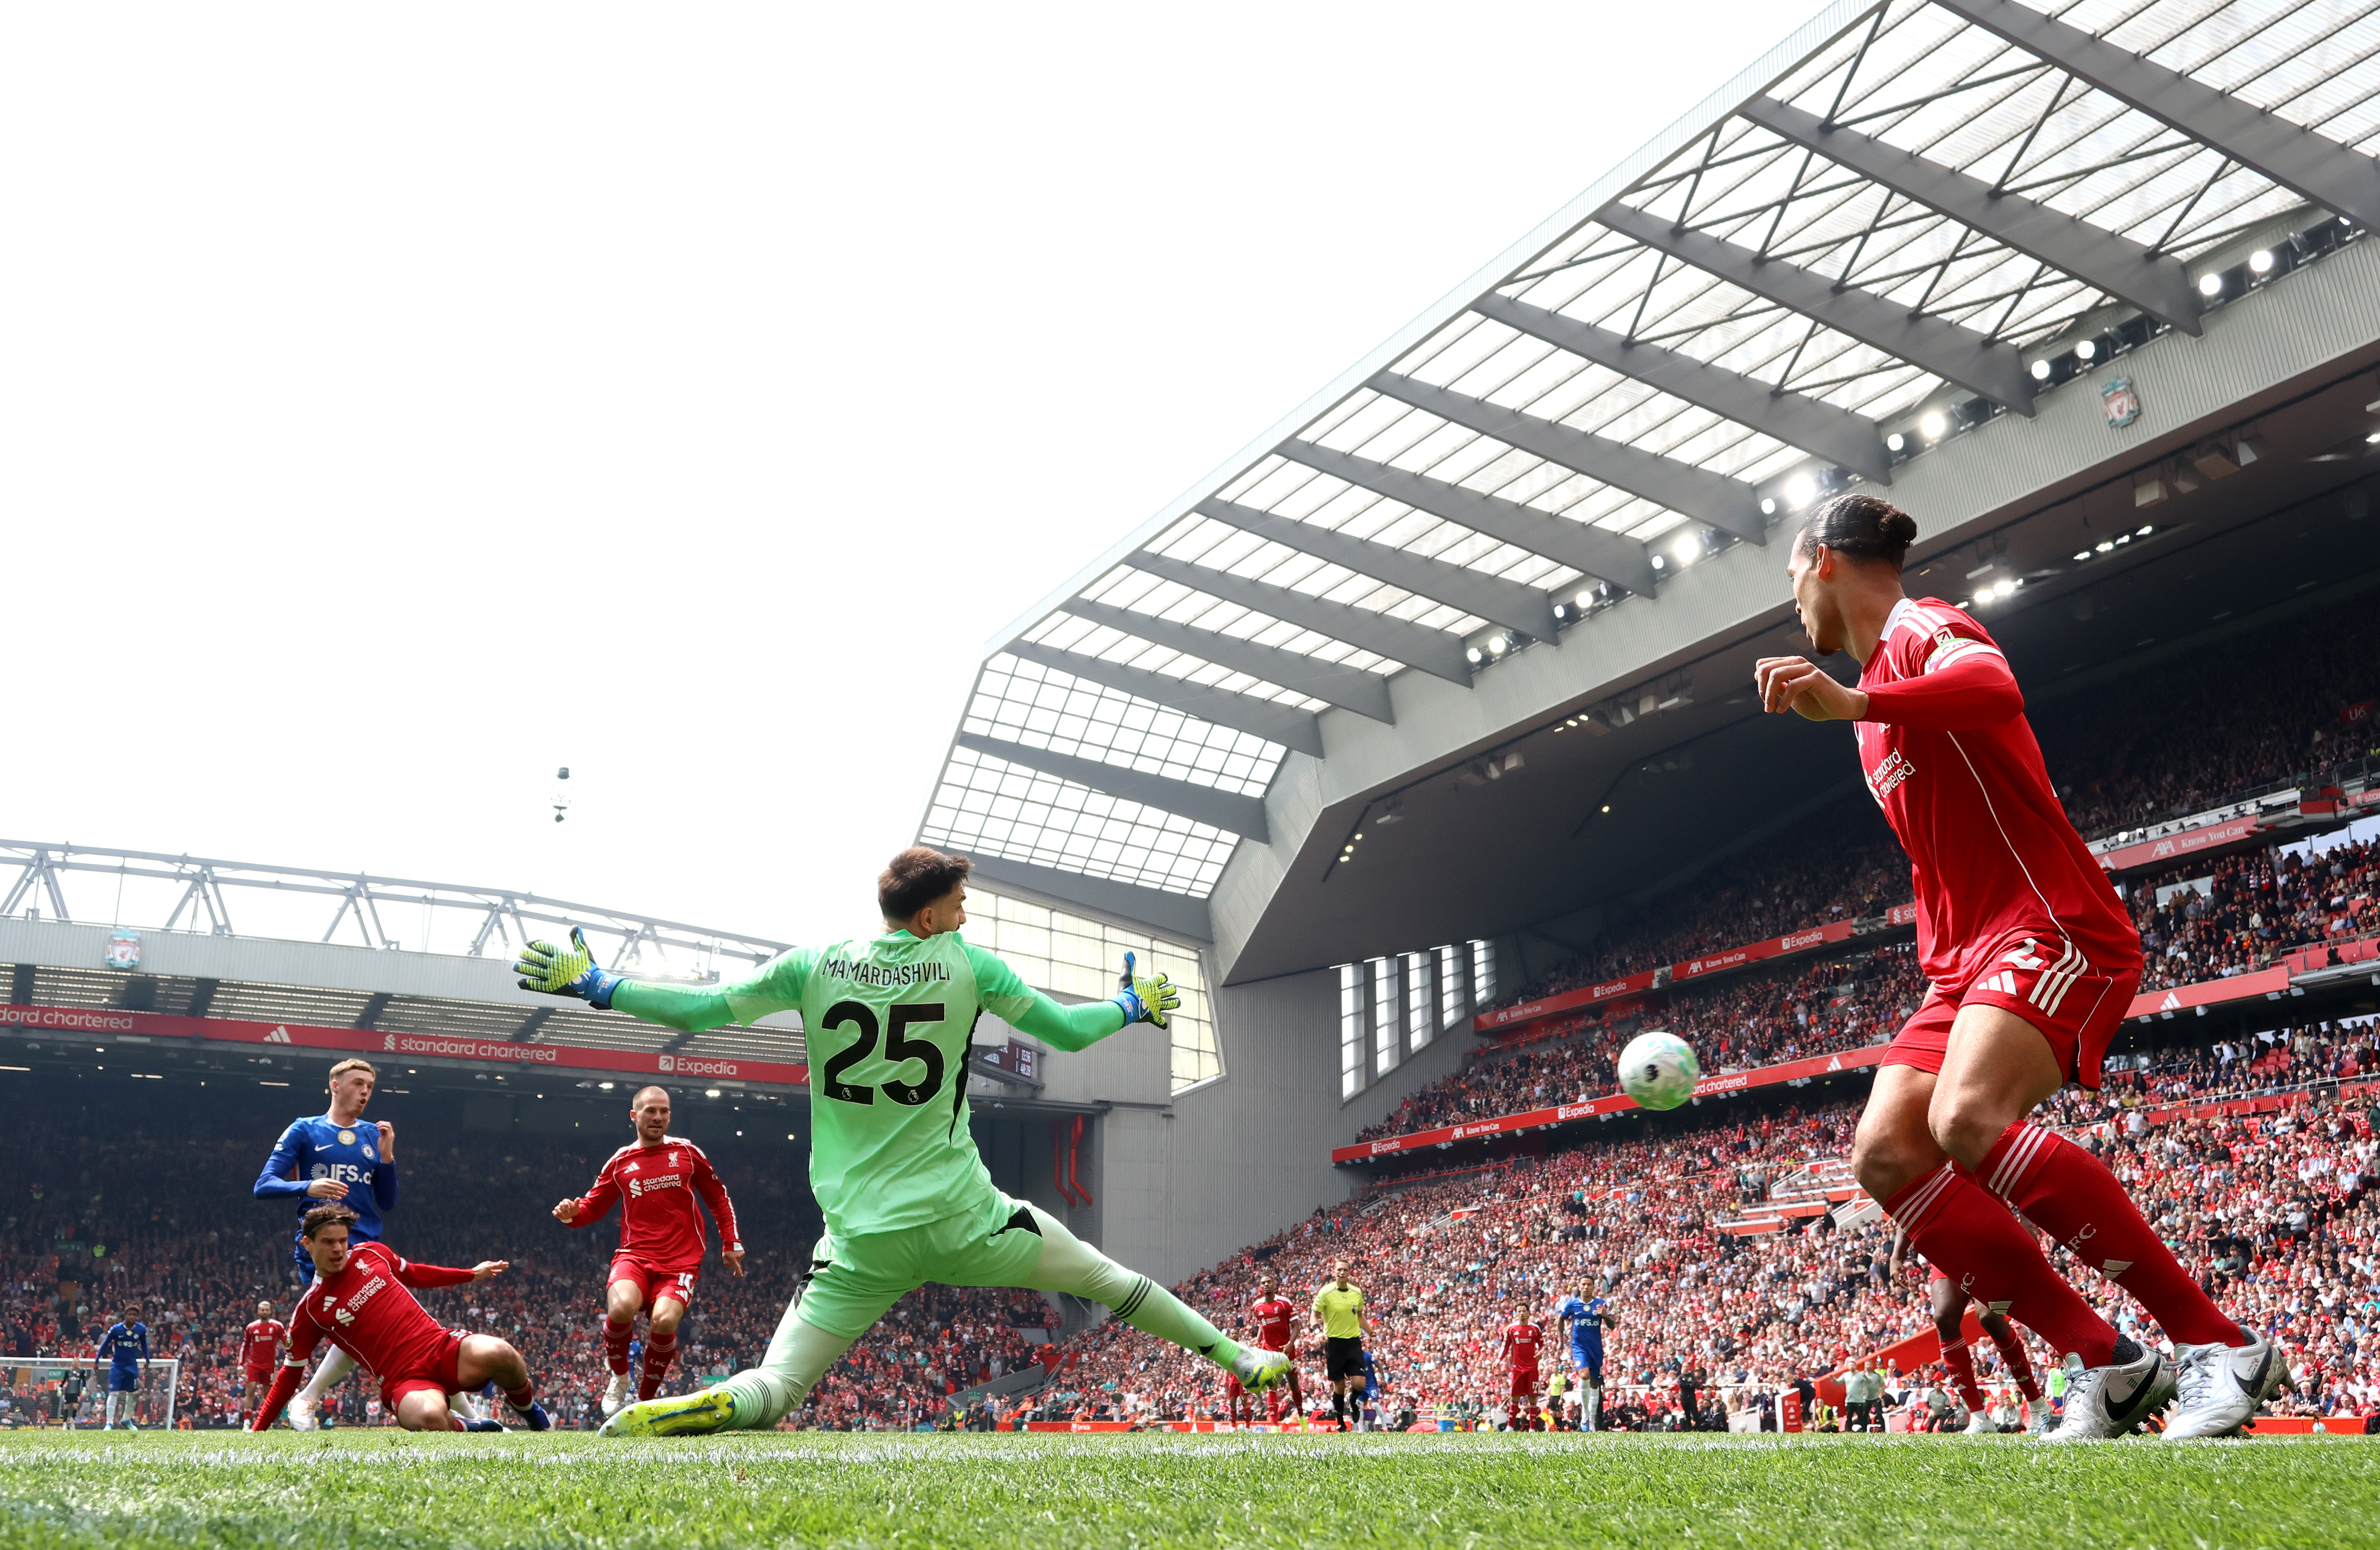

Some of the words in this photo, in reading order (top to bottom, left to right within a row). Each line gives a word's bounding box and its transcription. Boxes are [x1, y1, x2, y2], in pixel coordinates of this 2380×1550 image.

[1872, 747, 1902, 785] standard
[1879, 760, 1916, 799] chartered
[2151, 839, 2176, 858] AXA
[2181, 835, 2207, 848] Know
[2208, 832, 2226, 841] You
[2226, 826, 2245, 837] Can
[1791, 931, 1823, 947] Expedia
[821, 958, 951, 986] MAMARDASHVILI
[43, 1010, 133, 1029] chartered
[400, 1038, 475, 1055] standard
[478, 1043, 556, 1061] chartered
[821, 1000, 945, 1106] 25
[676, 1057, 737, 1075] Expedia
[1706, 1074, 1747, 1092] chartered
[1566, 1103, 1595, 1118] Expedia
[330, 1164, 375, 1185] IFS.a
[643, 1174, 680, 1186] standard
[644, 1180, 682, 1192] chartered
[2068, 1223, 2097, 1253] FC
[347, 1275, 381, 1307] standard
[352, 1278, 387, 1312] chartered
[650, 1358, 666, 1367] LFC
